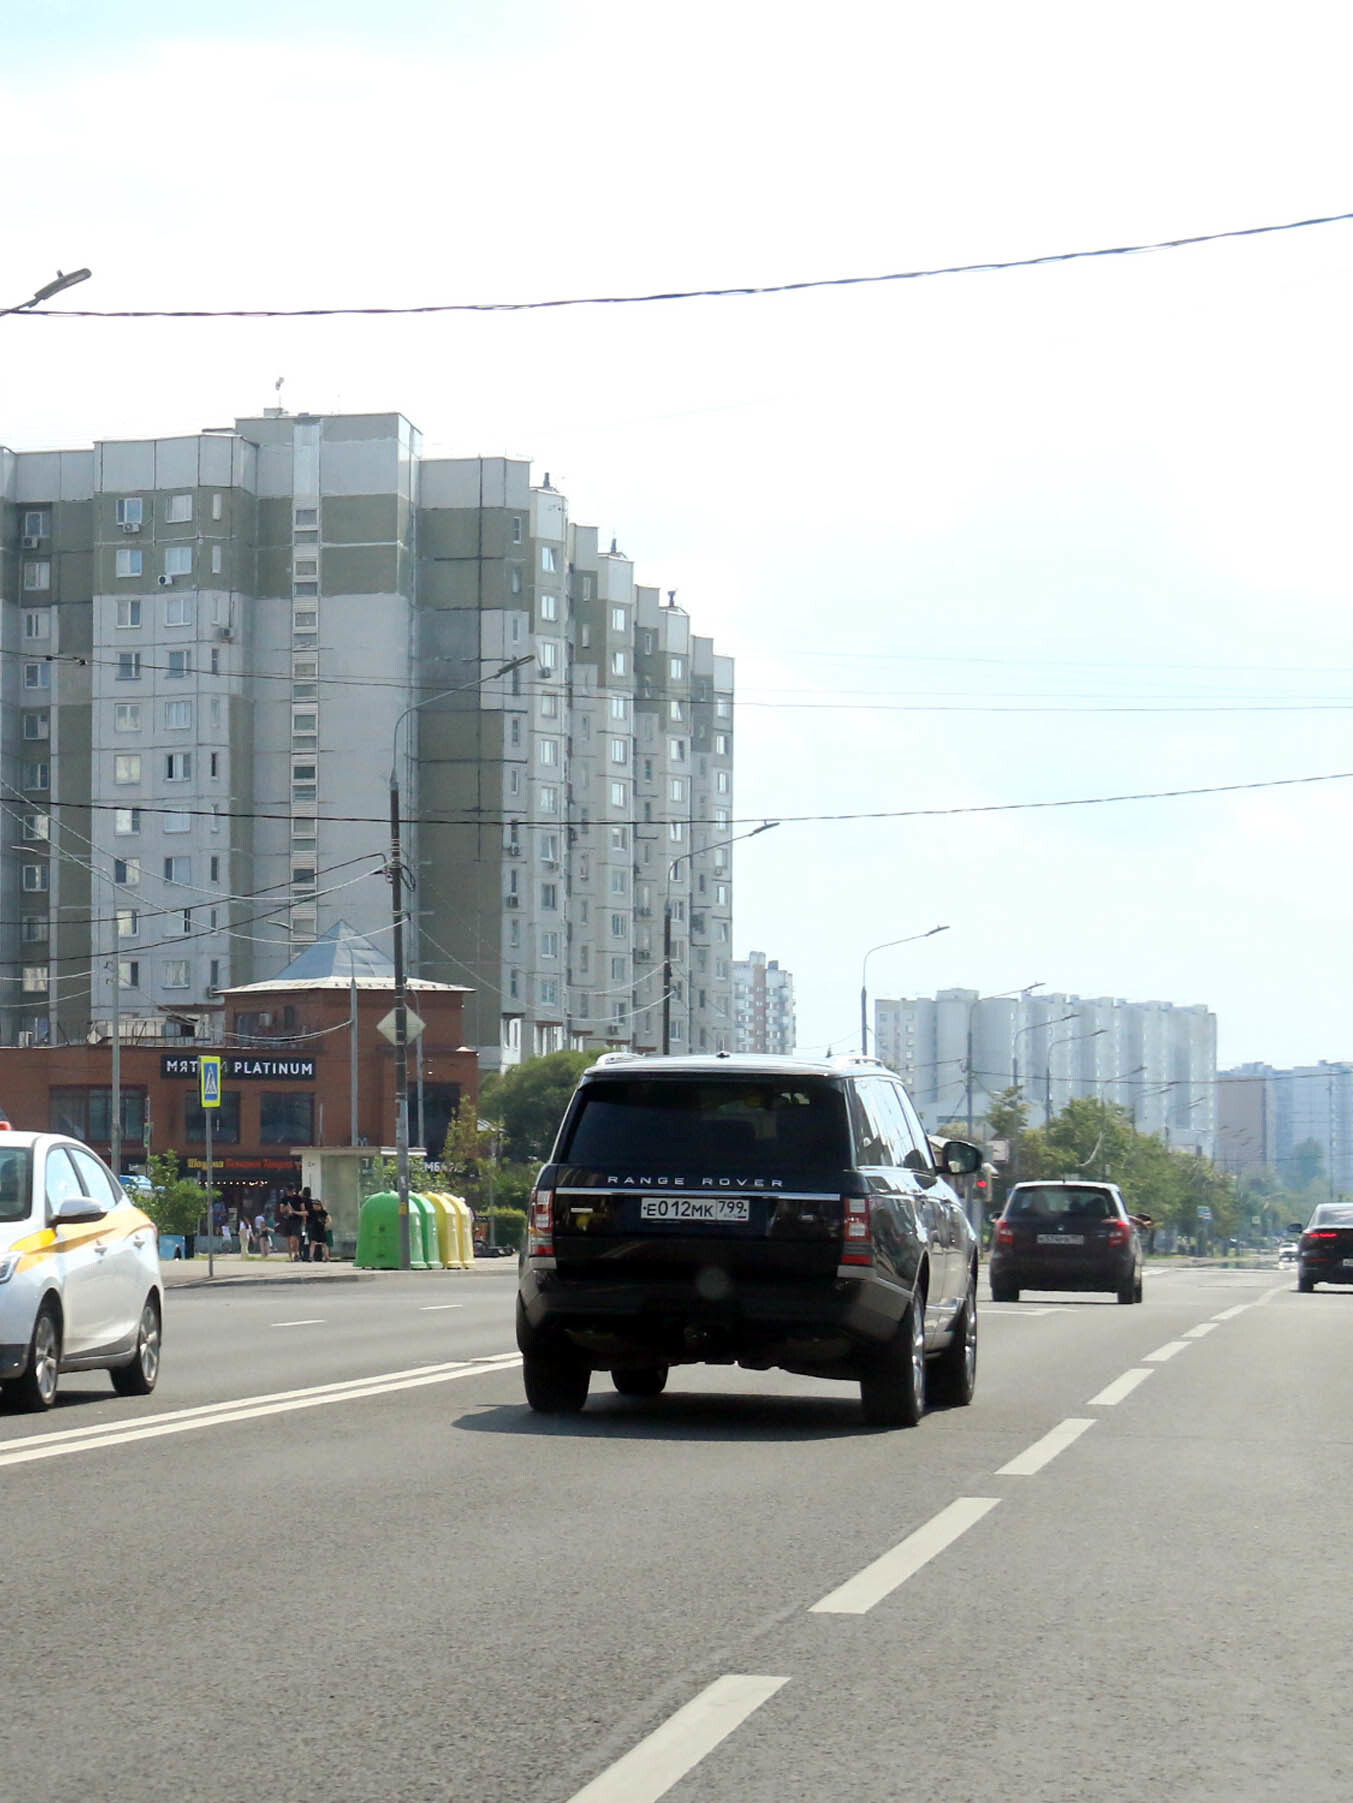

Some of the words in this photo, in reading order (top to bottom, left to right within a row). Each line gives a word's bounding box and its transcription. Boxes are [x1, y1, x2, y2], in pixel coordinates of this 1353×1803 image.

[234, 1062, 313, 1075] PLATINUM
[607, 1176, 685, 1185] RANGE
[702, 1177, 783, 1187] ROVER
[646, 1200, 713, 1217] Е012МК
[718, 1200, 745, 1214] 799
